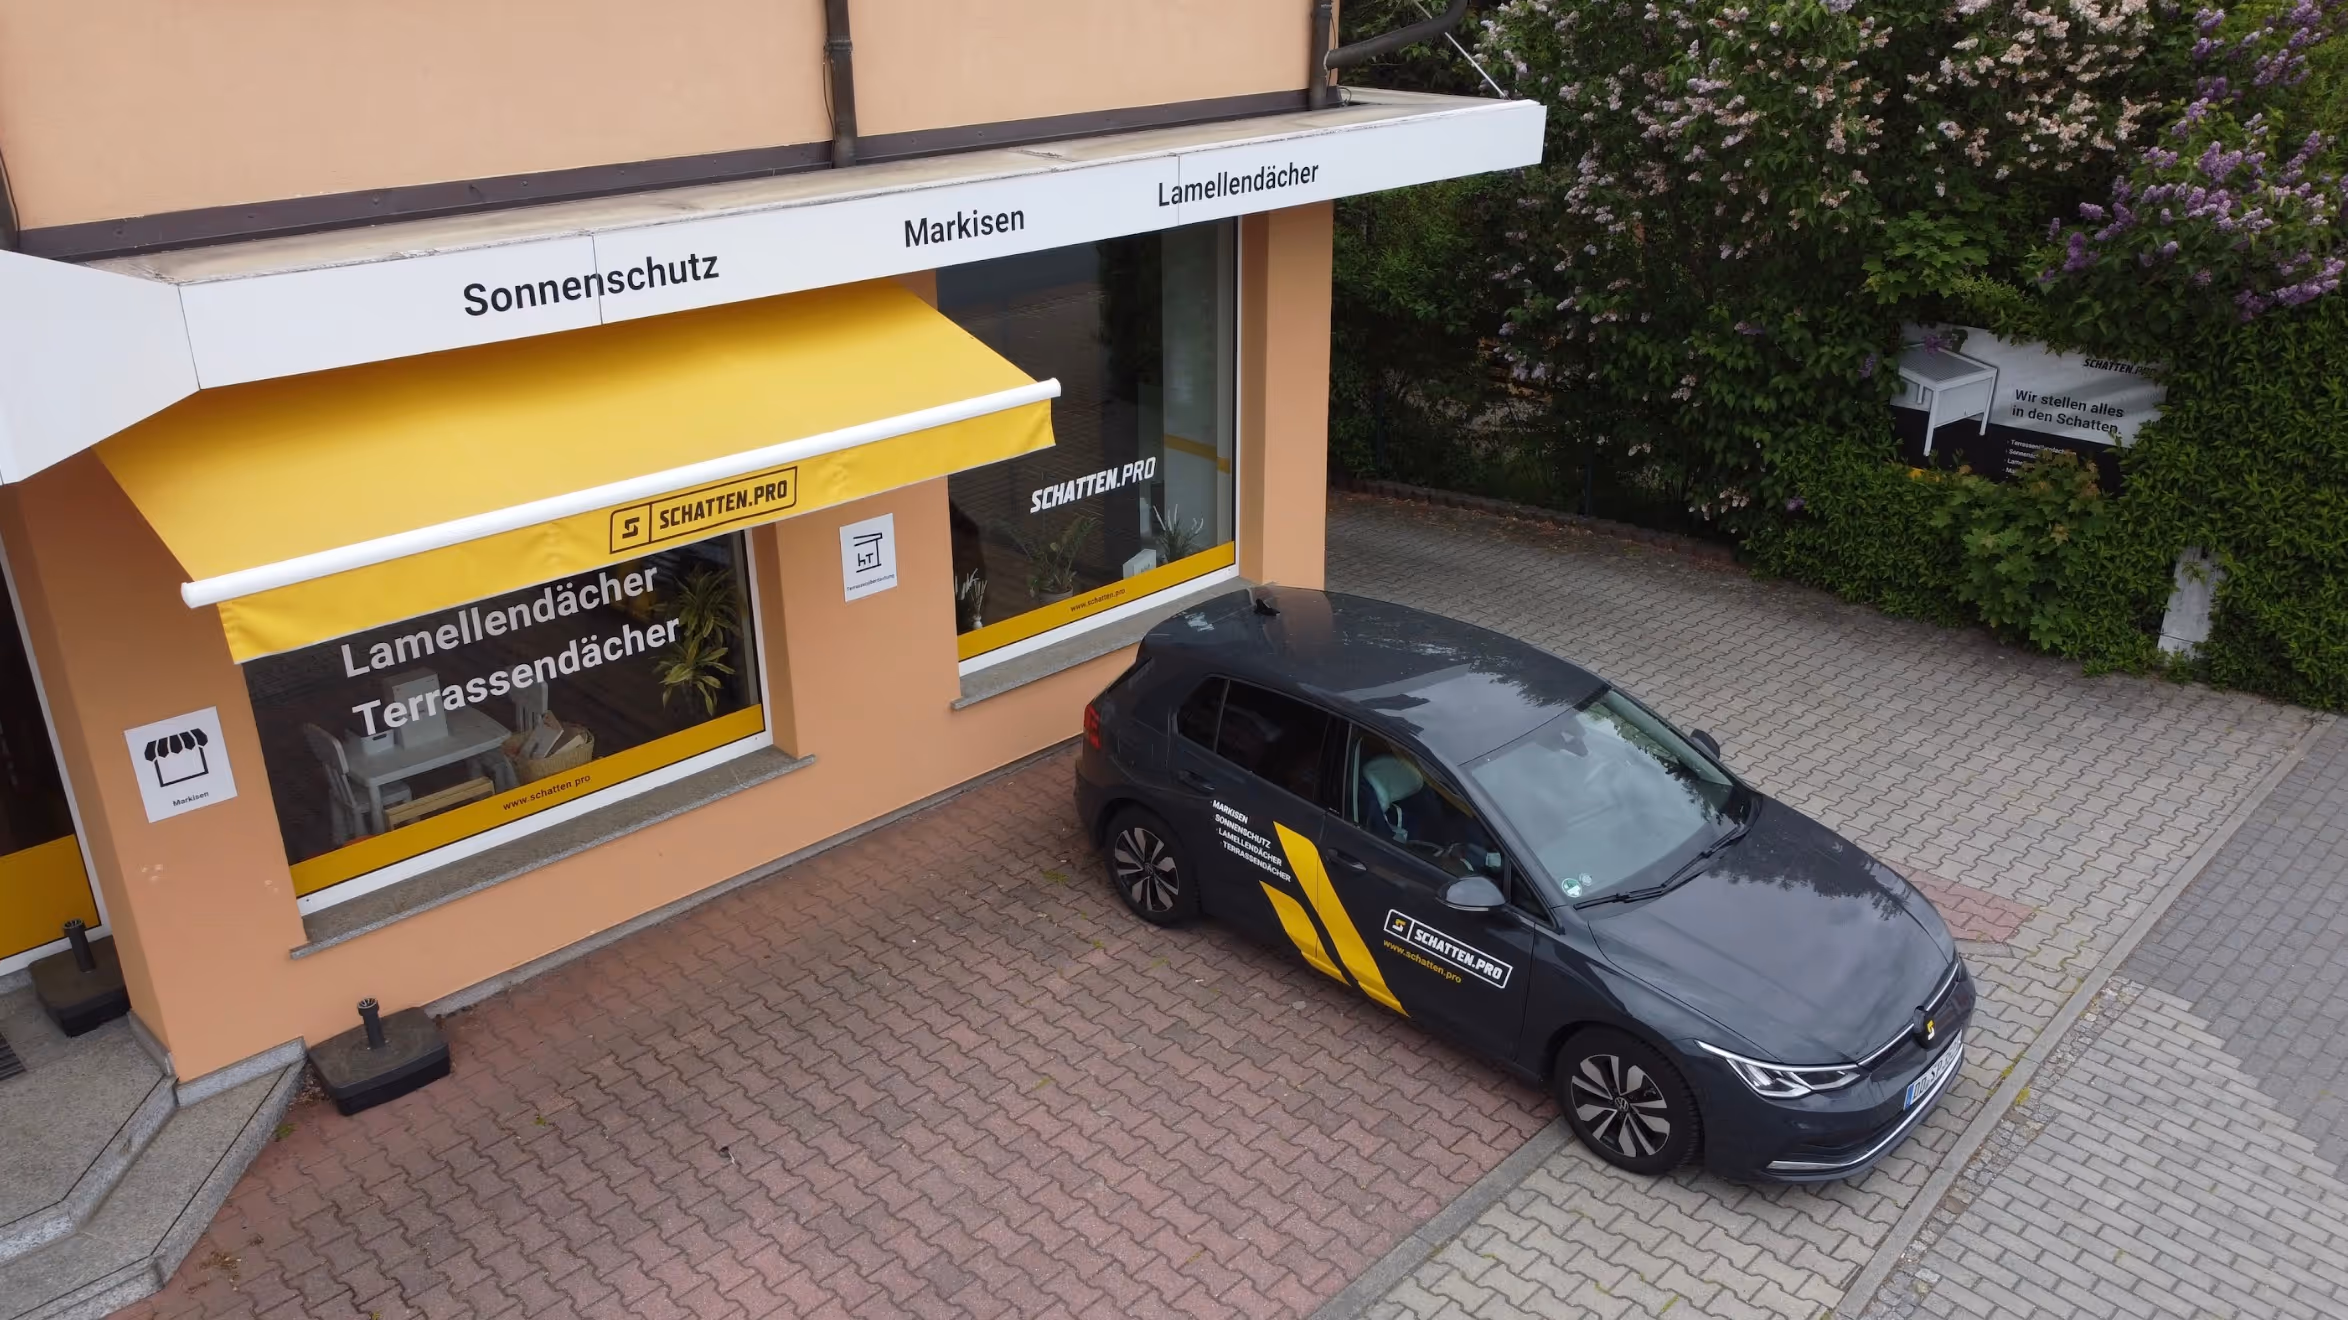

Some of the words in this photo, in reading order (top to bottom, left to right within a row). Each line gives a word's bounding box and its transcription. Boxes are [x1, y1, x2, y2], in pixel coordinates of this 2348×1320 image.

[1158, 161, 1319, 207] Lamellendächer
[904, 208, 1025, 248] Markisen
[463, 253, 720, 316] Sonnenschutz
[2012, 405, 2024, 417] in
[2028, 408, 2052, 422] den
[2056, 413, 2121, 434] Schatten.
[2015, 389, 2037, 403] Wir
[2041, 395, 2087, 411] stellen
[2090, 402, 2124, 418] alles
[659, 480, 788, 529] SCHATTEN.PRO
[1030, 456, 1156, 514] SCHATTEN.PRO
[340, 566, 658, 678] Lamellendächer
[352, 617, 681, 736] Terrassendächer
[172, 791, 209, 807] Markisen
[1212, 800, 1248, 824] MARKISEN
[1215, 814, 1271, 849] SONNENSCHUTZ
[1218, 827, 1282, 866] LAMELLENDÄCHER
[1222, 840, 1291, 883] TERRASSENDÄCHER
[1383, 939, 1462, 983] www.schatten.pro
[1414, 928, 1503, 980] SCHATTEN.PRO
